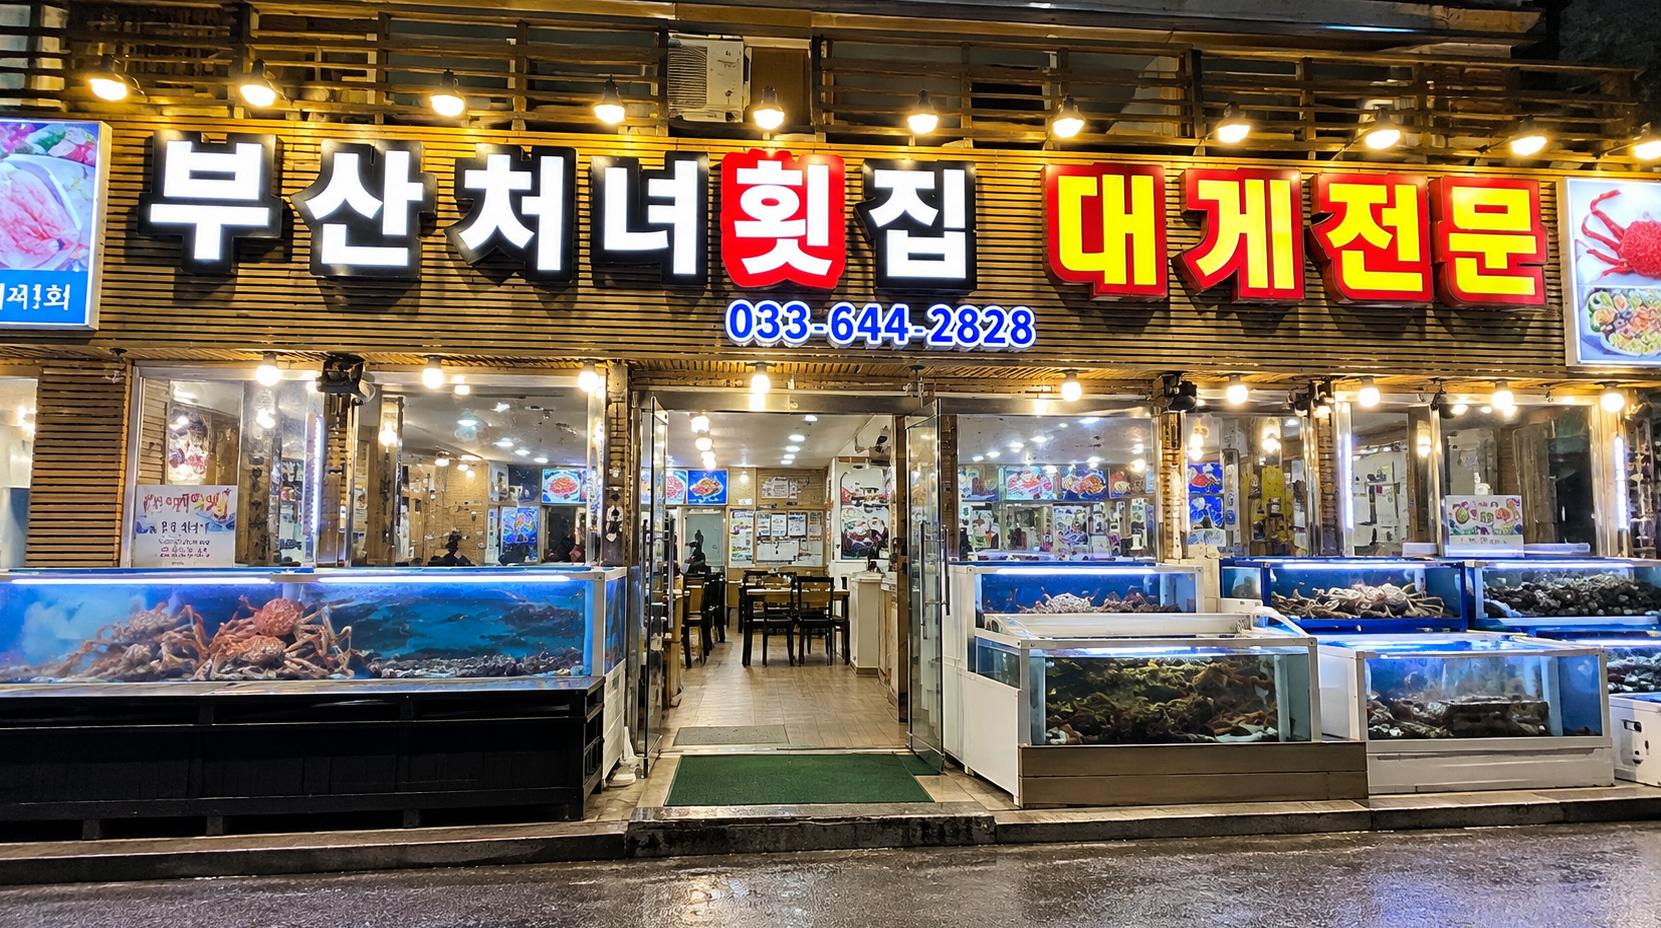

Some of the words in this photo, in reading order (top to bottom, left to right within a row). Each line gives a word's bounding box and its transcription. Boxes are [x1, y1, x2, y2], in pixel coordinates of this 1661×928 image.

[151, 141, 966, 279] 부산처녀횟집
[1059, 174, 1537, 296] 대게전문
[727, 301, 1035, 346] 033-644-2828
